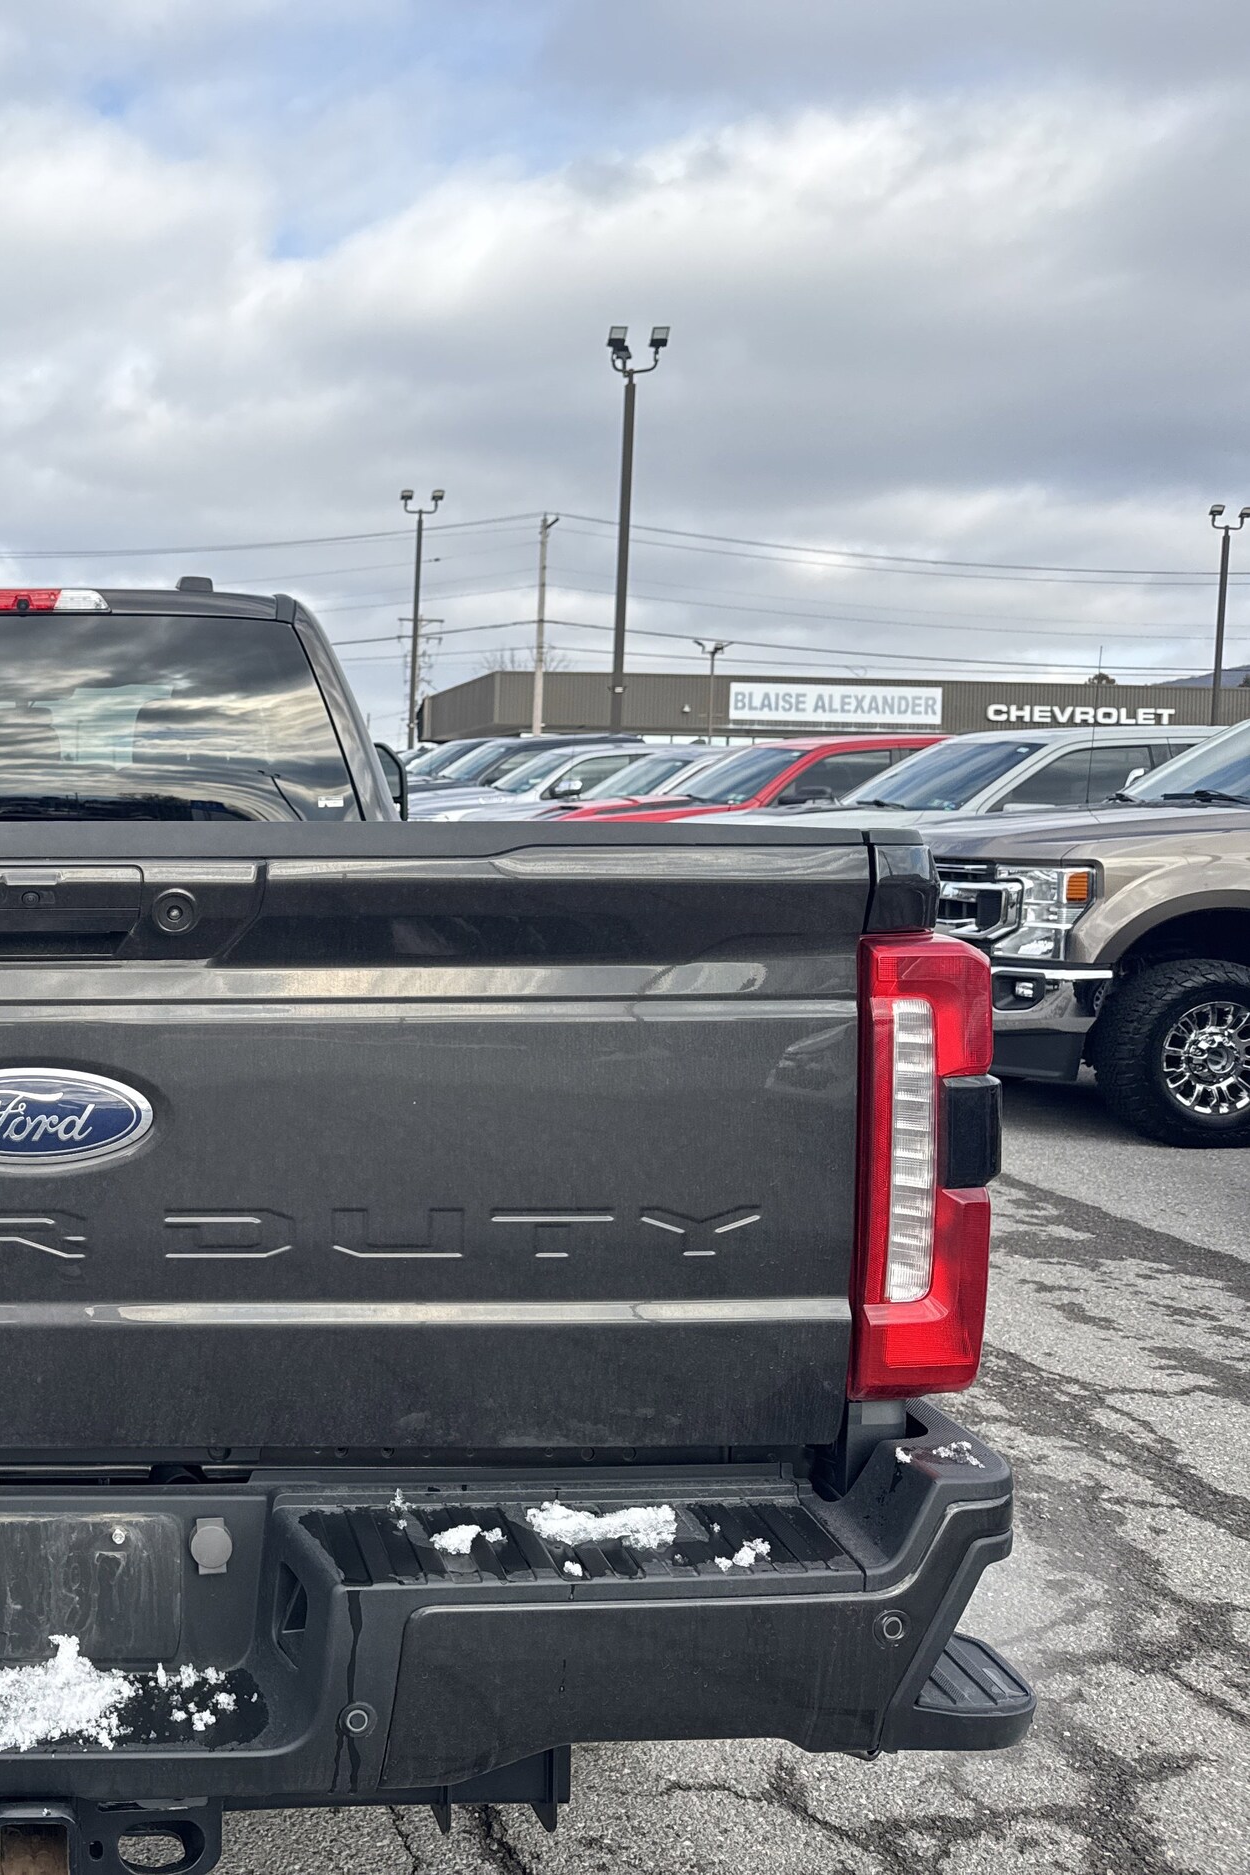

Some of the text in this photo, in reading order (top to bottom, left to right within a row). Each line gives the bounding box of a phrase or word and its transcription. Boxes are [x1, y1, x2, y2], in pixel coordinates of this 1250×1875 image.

[733, 691, 938, 716] BLAISE ALEXANDER
[986, 703, 1176, 725] CHEVROLET
[163, 1205, 762, 1261] DUTY
